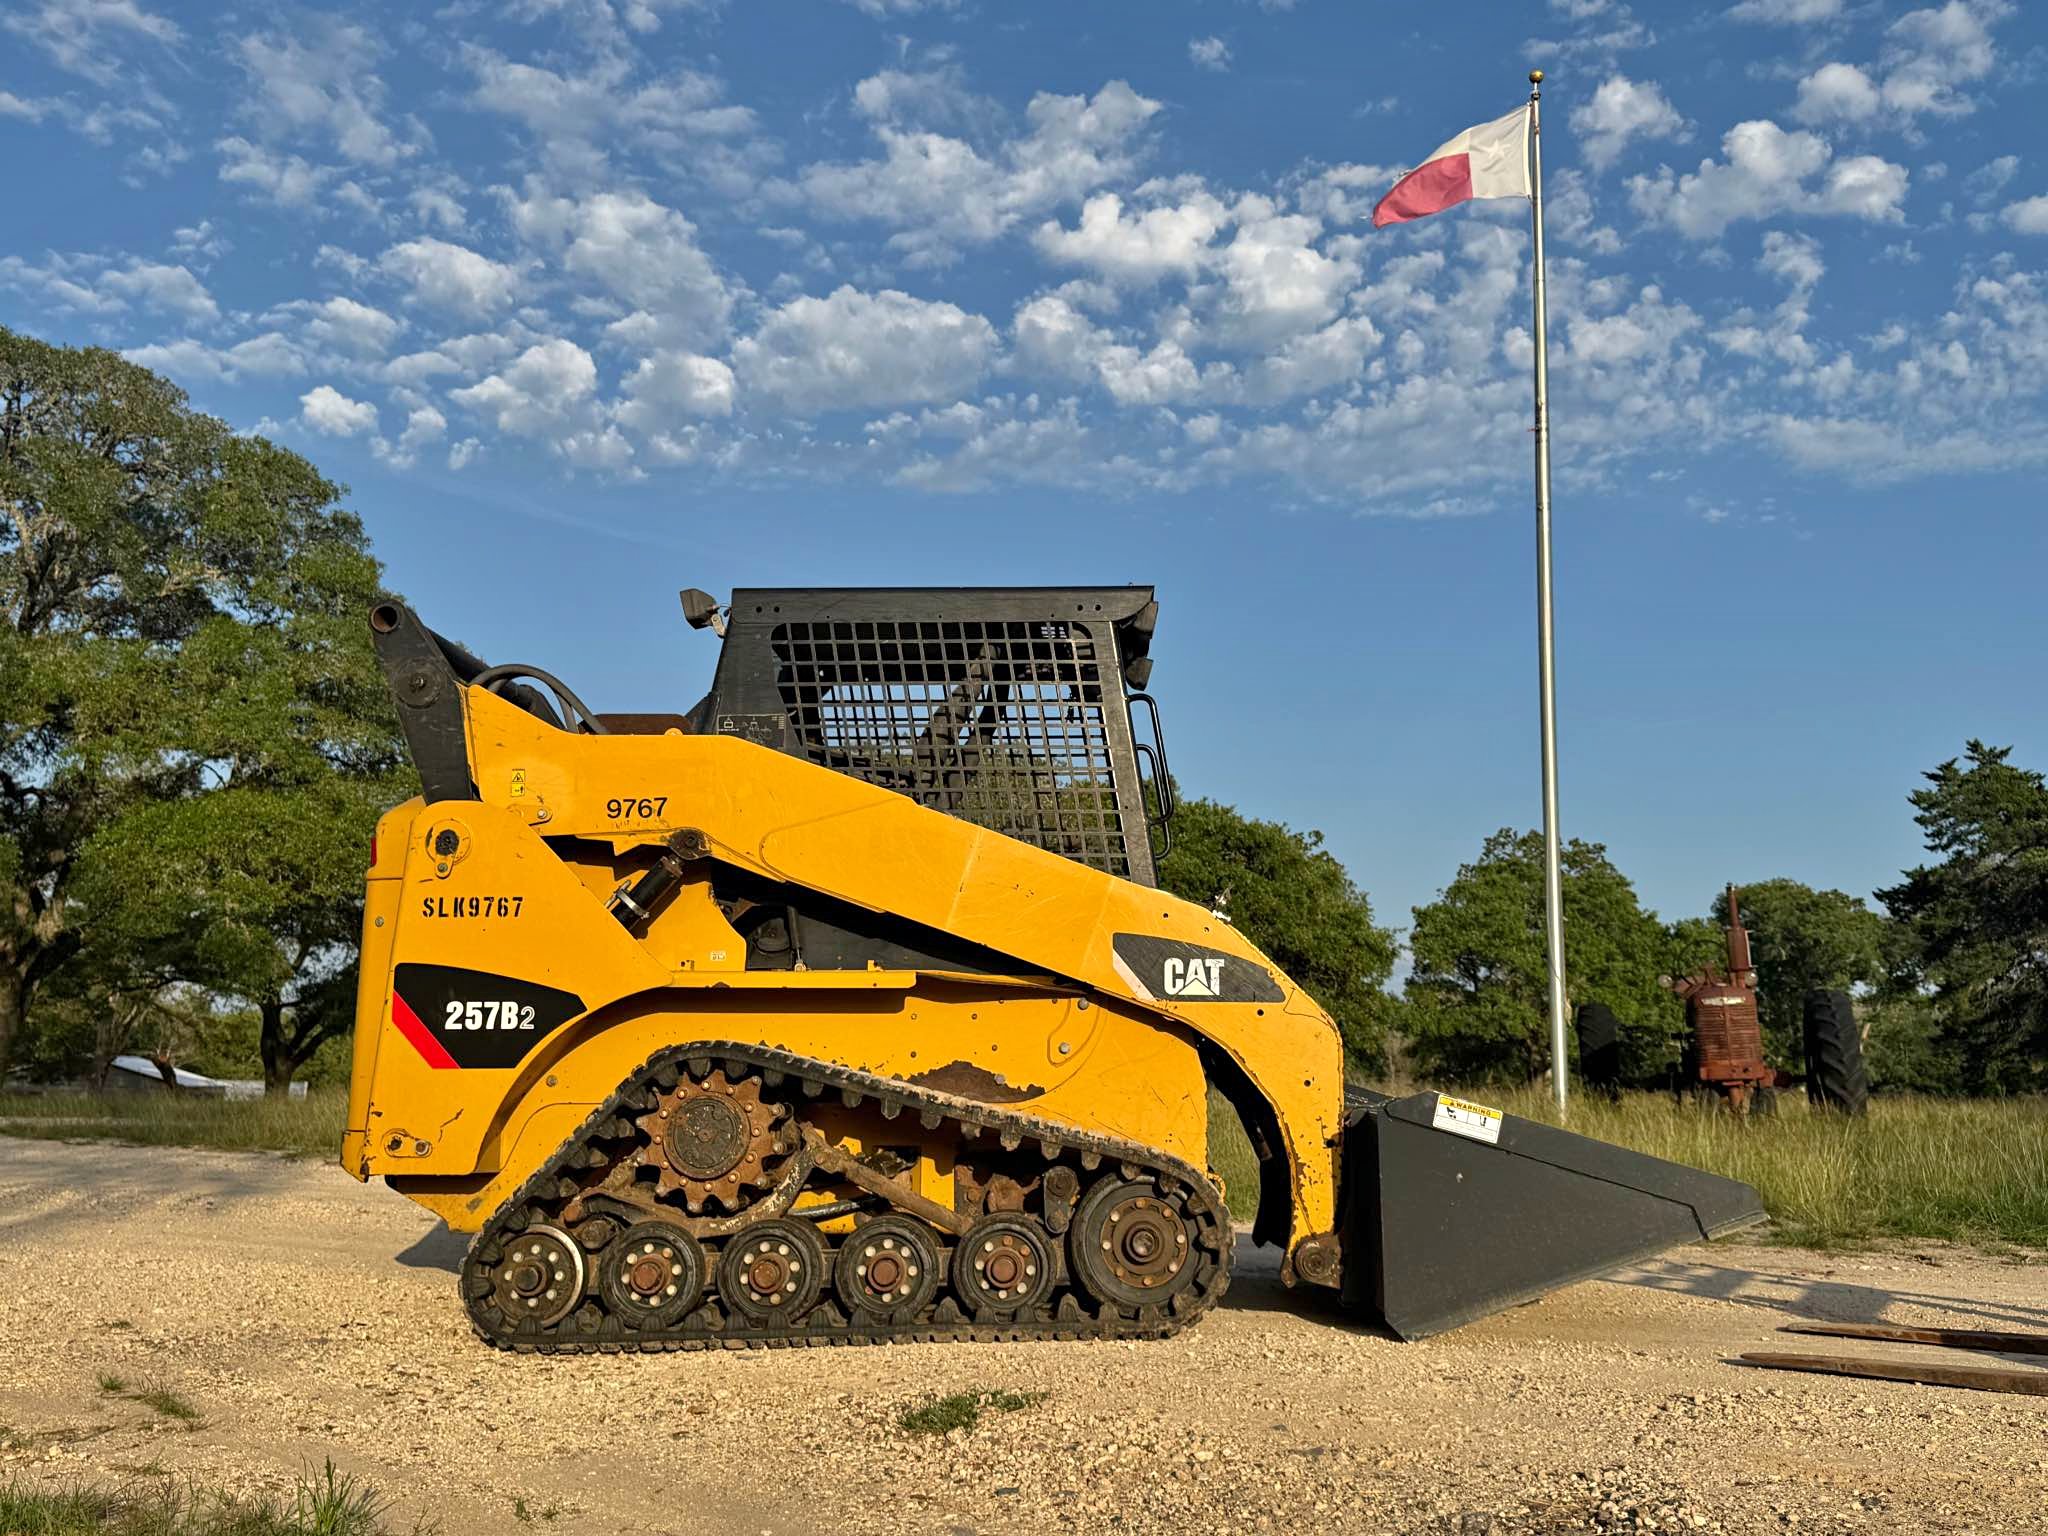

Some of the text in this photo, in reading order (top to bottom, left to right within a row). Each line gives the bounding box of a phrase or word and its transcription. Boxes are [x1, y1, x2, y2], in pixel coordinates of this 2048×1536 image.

[607, 797, 668, 819] 9767
[422, 897, 523, 918] SLK9767
[1164, 958, 1225, 996] CAT
[445, 1001, 535, 1030] 257B2
[1455, 1102, 1492, 1116] WARNING
